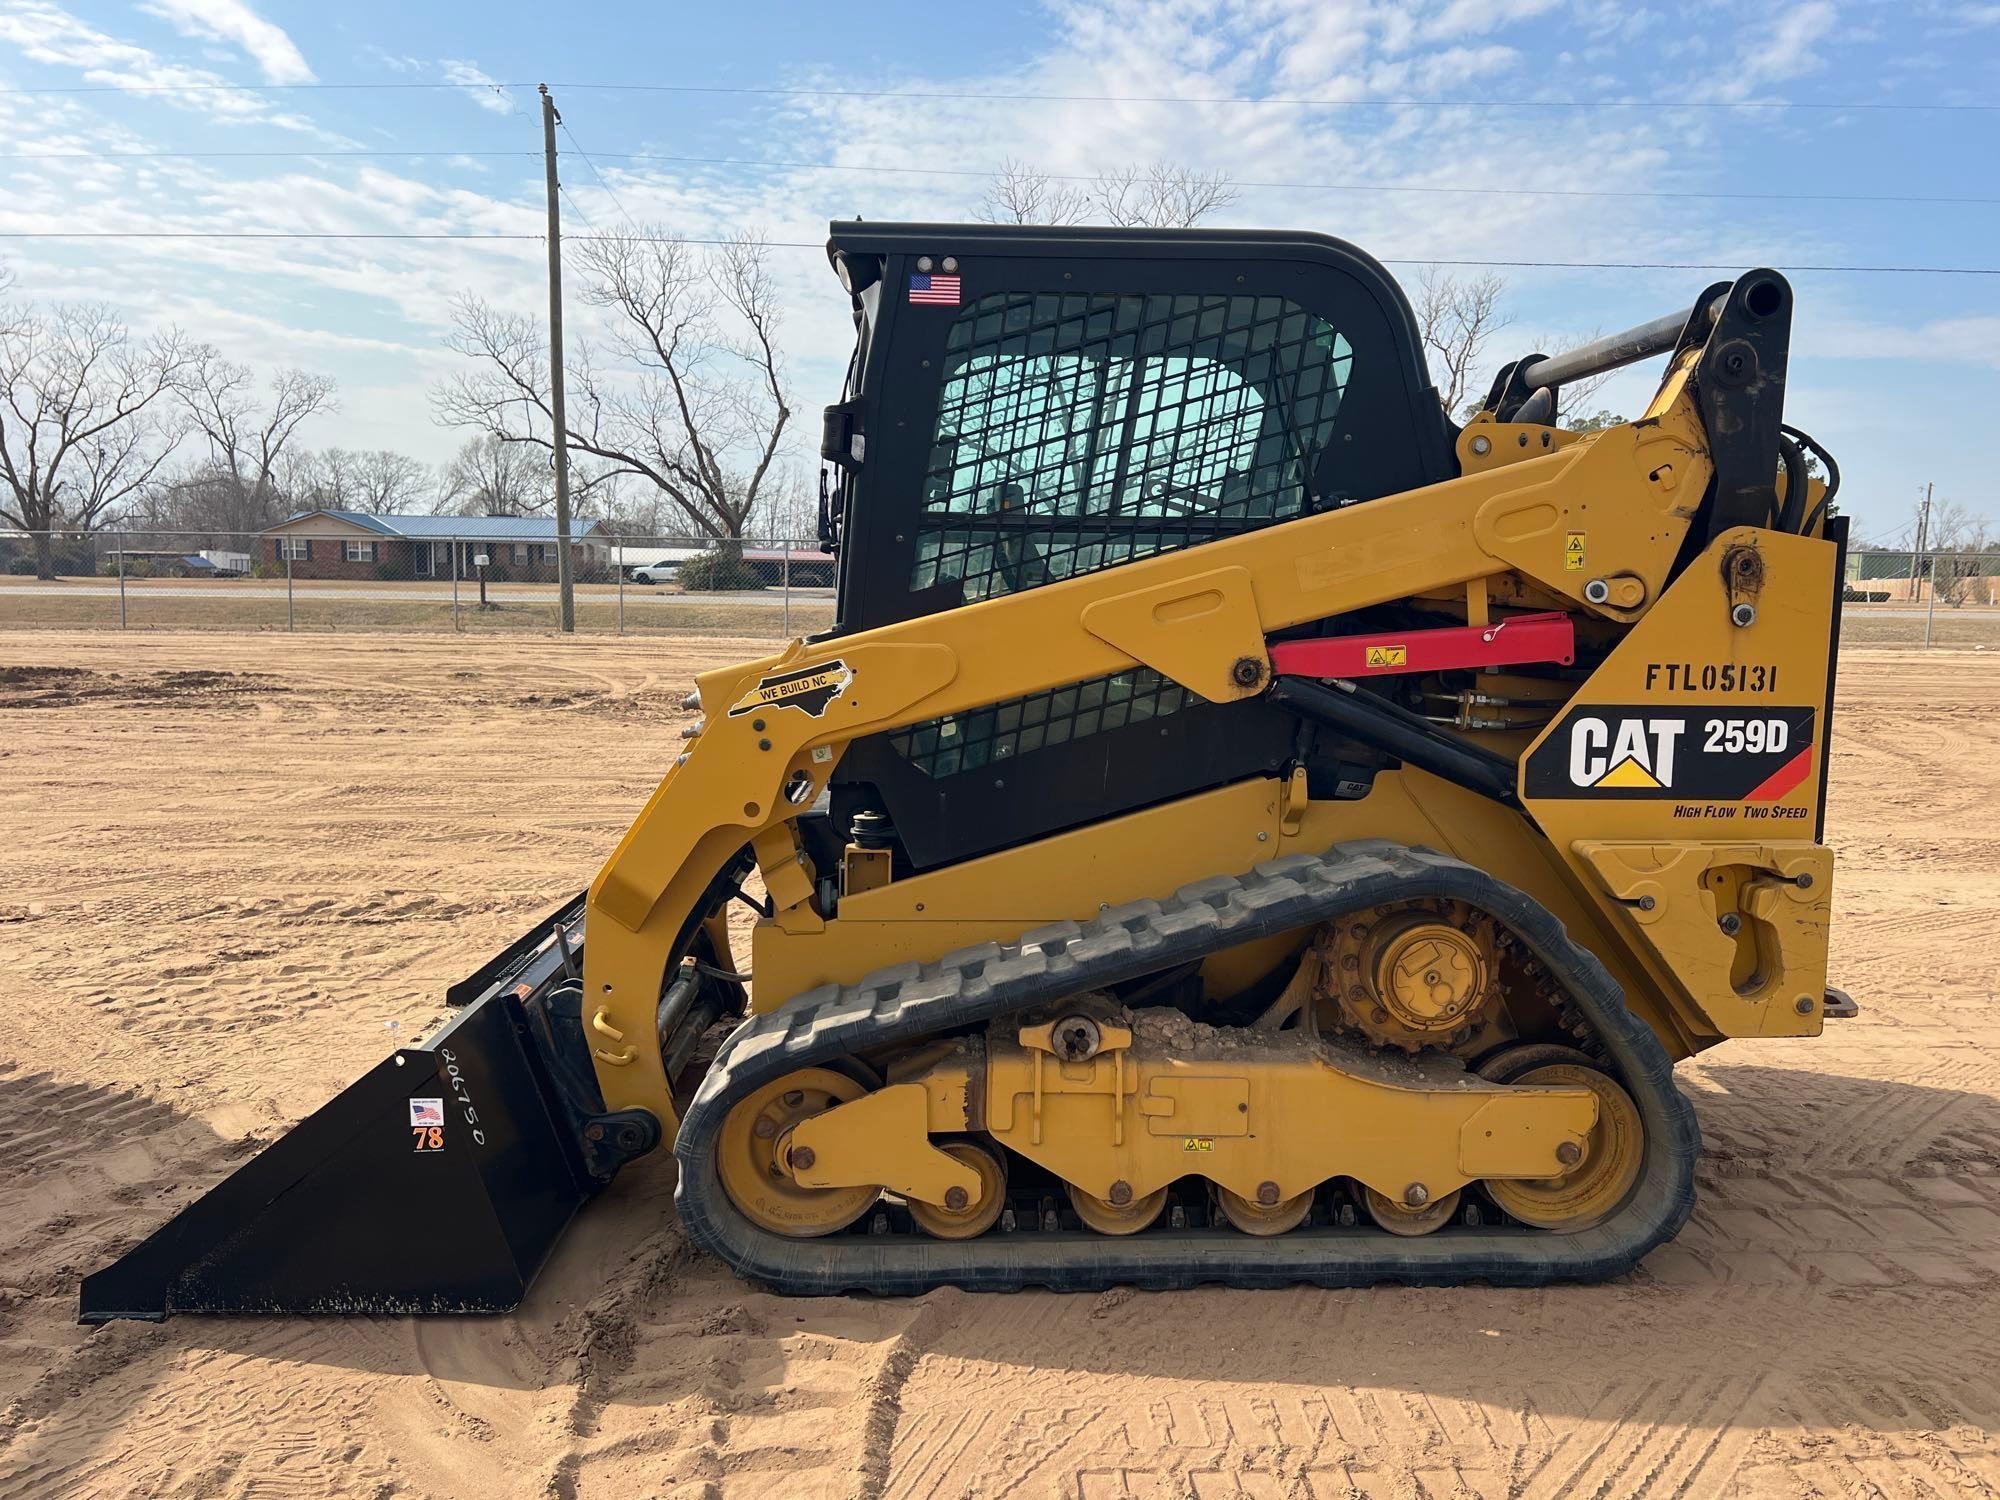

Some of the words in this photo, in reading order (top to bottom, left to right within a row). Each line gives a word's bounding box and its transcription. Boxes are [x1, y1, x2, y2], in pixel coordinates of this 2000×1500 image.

[760, 688, 778, 701] WE
[780, 680, 810, 696] BUILD
[812, 675, 827, 687] NC
[1645, 664, 1777, 692] FTL05131
[1569, 717, 1686, 788] CAT
[1703, 719, 1789, 754] 259D
[441, 1048, 485, 1145] 206750
[412, 1126, 444, 1150] 78
